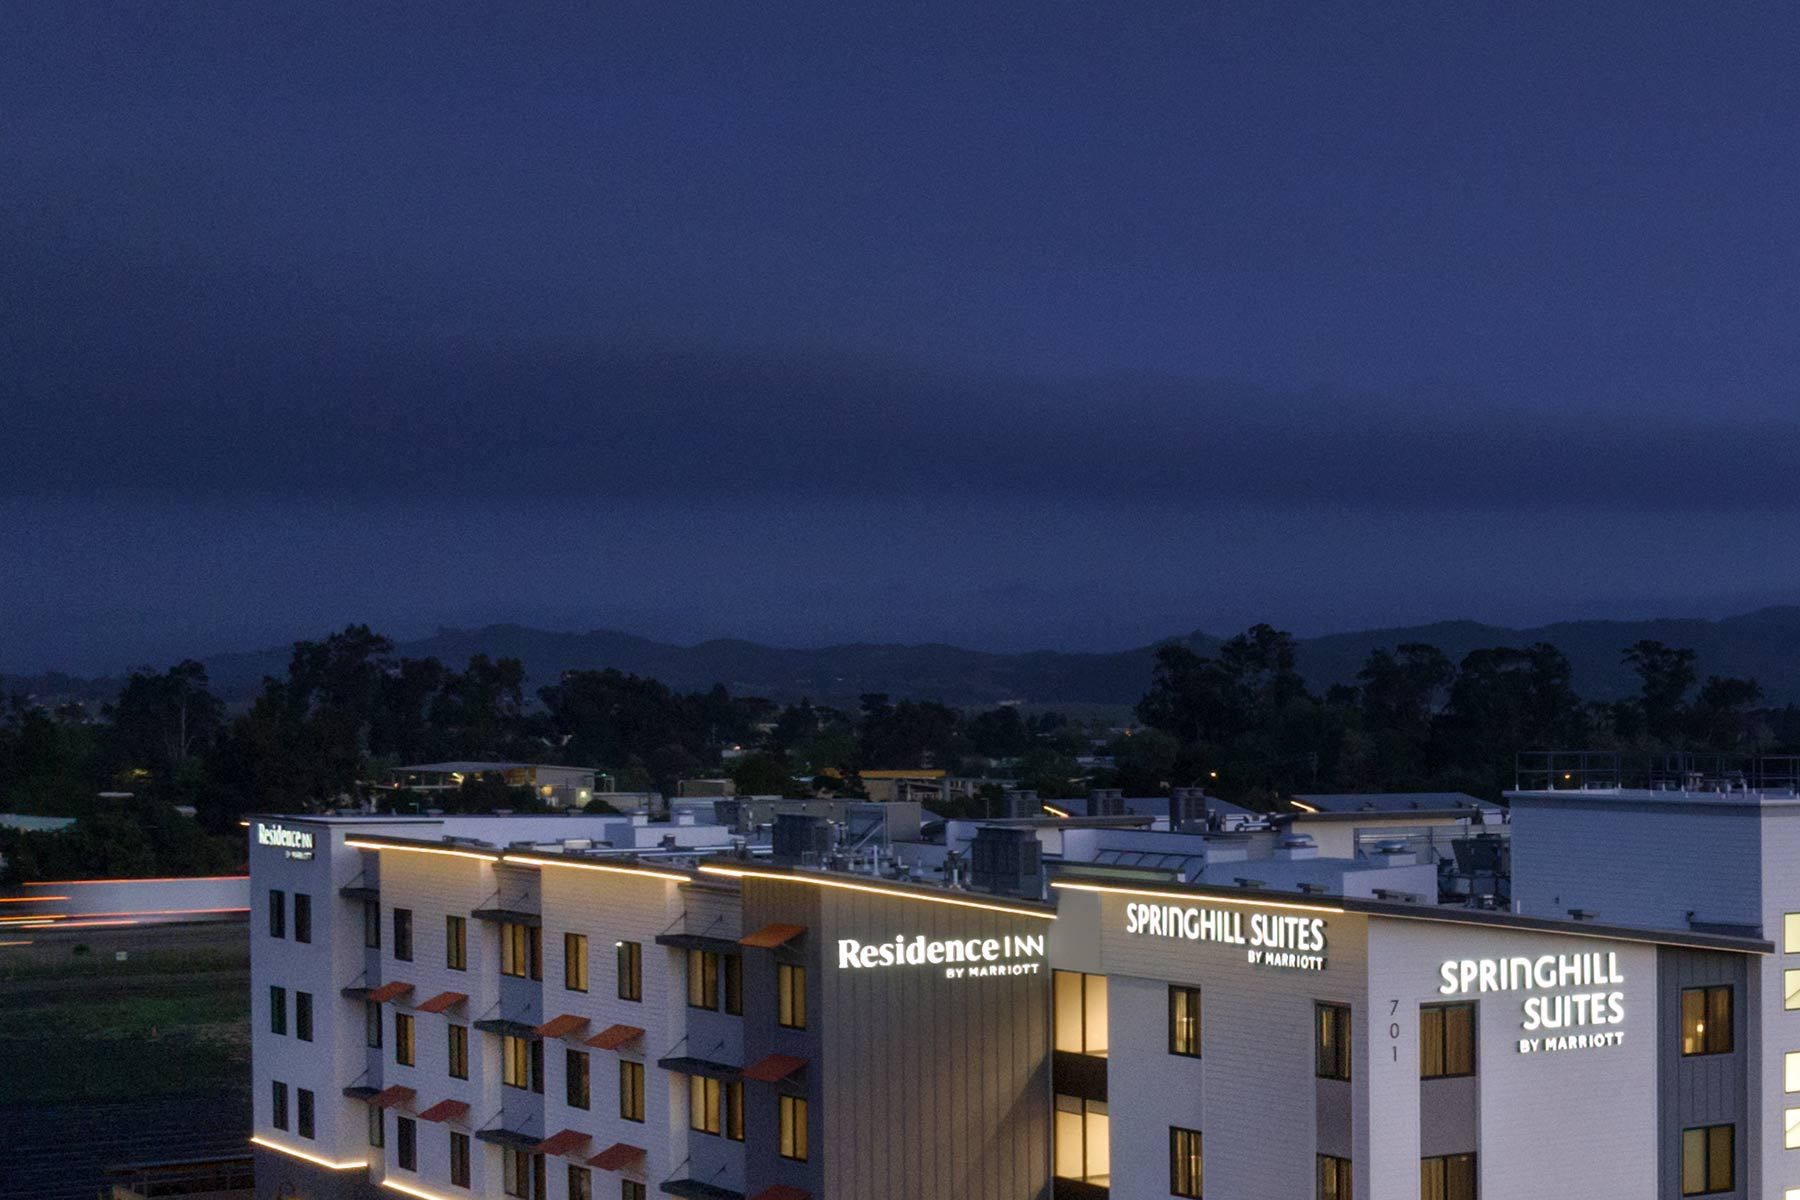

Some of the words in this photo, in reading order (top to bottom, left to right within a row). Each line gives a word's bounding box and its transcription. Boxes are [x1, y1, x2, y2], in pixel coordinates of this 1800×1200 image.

[1126, 902, 1246, 945] SPRINGHILL
[1250, 913, 1325, 952] SUITES
[837, 934, 1000, 969] Residence
[1004, 934, 1045, 958] INN
[1247, 949, 1262, 964] BY
[1265, 952, 1325, 971] MARRIOTT
[945, 968, 964, 979] BY
[968, 963, 1040, 978] MARRIOTT
[1439, 951, 1625, 995] SPRINGHILL
[1522, 991, 1625, 1031] SUITES
[1389, 999, 1400, 1062] 701
[1518, 1038, 1540, 1054] BY
[1544, 1031, 1625, 1051] MARRIOTT
